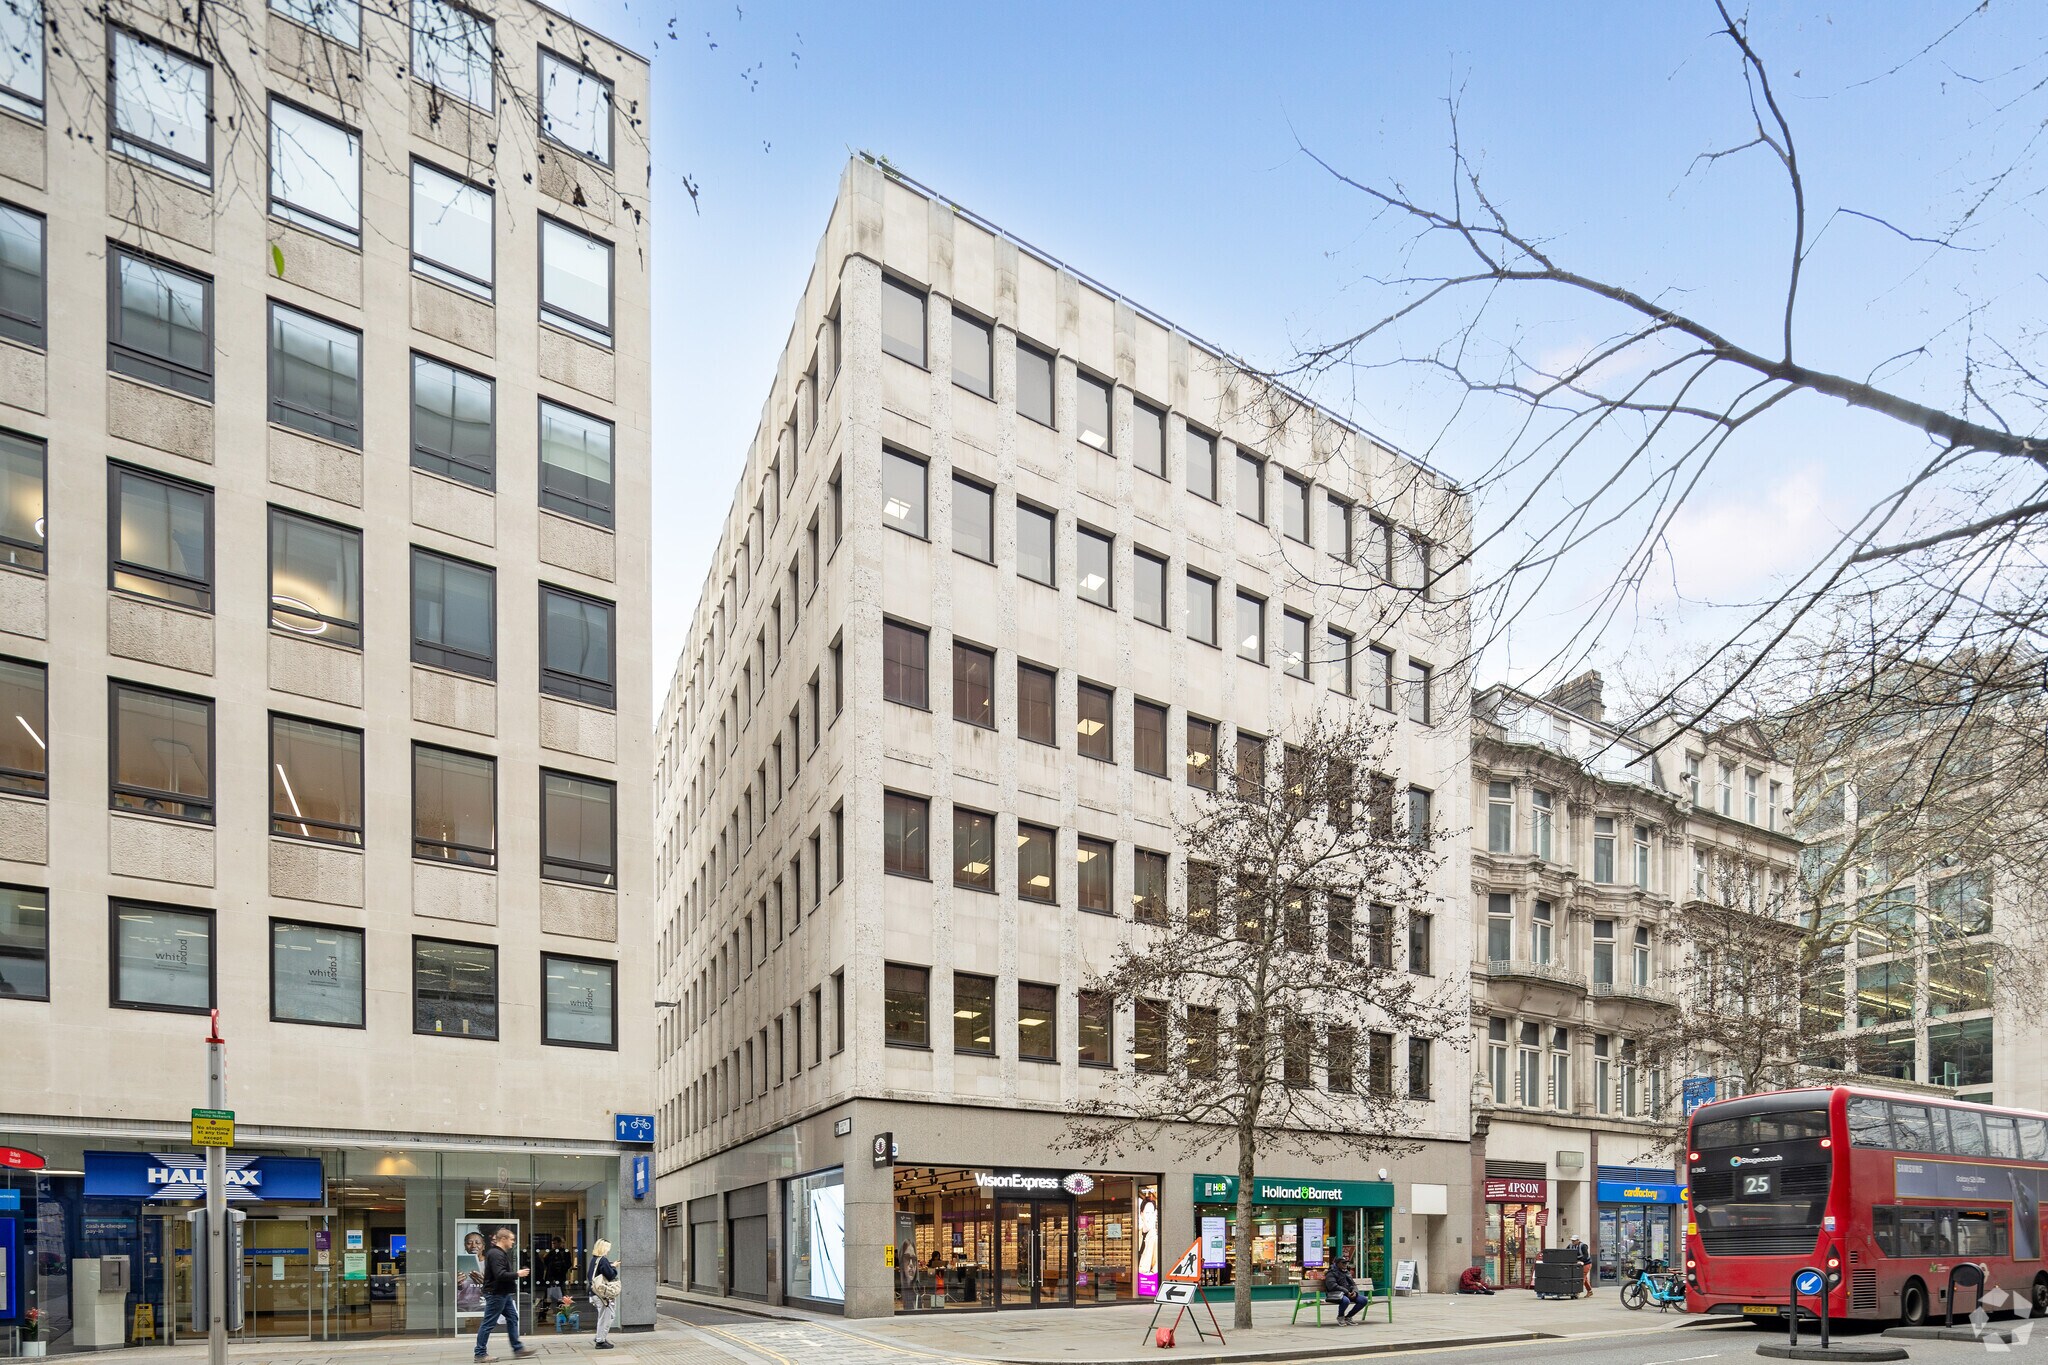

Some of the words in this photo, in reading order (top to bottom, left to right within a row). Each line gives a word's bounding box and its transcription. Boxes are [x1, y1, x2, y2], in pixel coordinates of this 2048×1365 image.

[1741, 1155, 1783, 1164] Stagecoach
[148, 1167, 261, 1186] HALAX
[1746, 1176, 1769, 1193] 25
